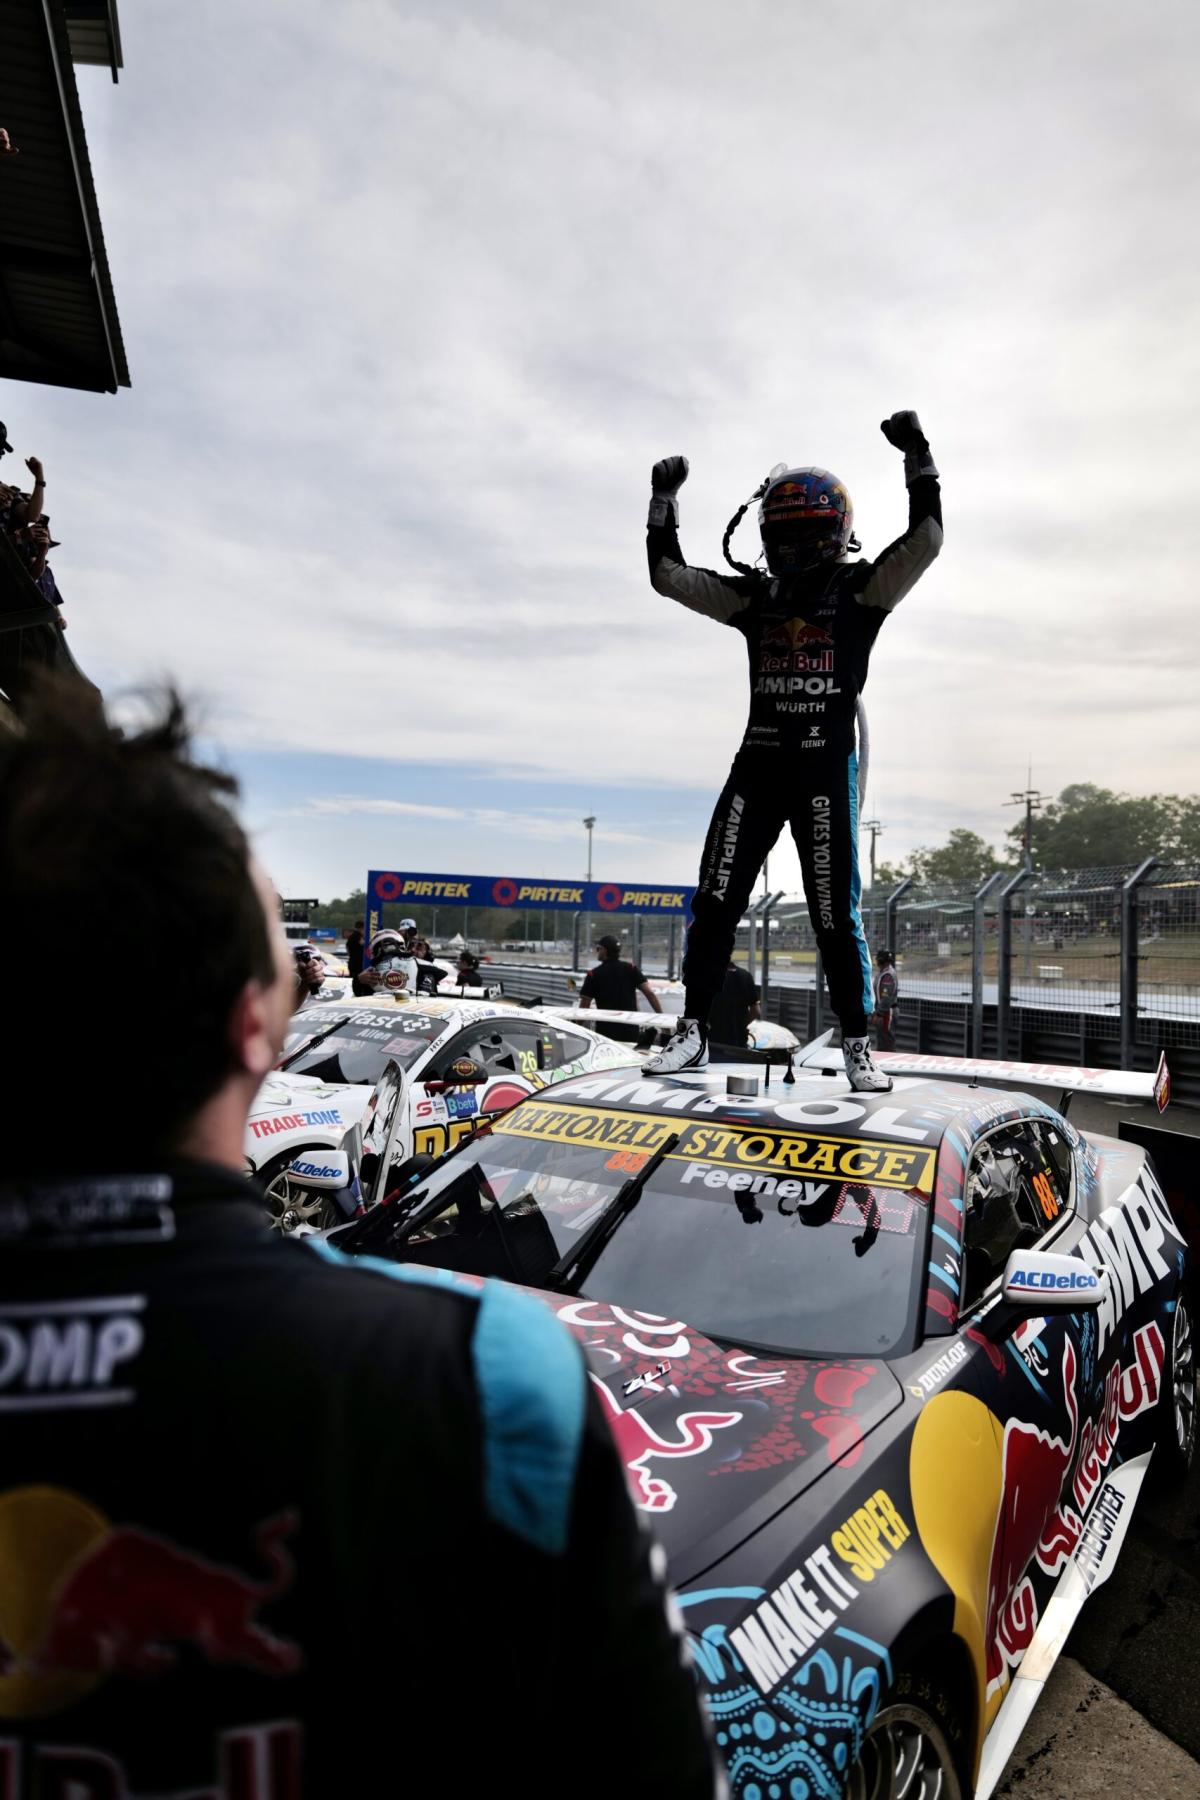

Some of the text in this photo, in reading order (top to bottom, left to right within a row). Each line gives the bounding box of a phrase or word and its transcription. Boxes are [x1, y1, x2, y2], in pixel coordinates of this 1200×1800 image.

[793, 649, 834, 673] Bull
[801, 739, 826, 749] FEENEY
[811, 795, 835, 931] GIVES YOU WINGS
[402, 880, 471, 898] PIRTEK
[518, 886, 584, 903] PIRTEK
[622, 891, 686, 908] PIRTEK
[357, 1028, 394, 1041] Allen
[519, 1050, 538, 1073] 26
[457, 1097, 475, 1111] betr
[542, 1078, 930, 1141] AMPOL
[249, 1109, 343, 1138] TRADEZONE
[502, 1106, 918, 1183] NATIONAL STORAGE
[288, 1160, 342, 1178] ACDelco
[604, 1150, 651, 1174] 88
[680, 1163, 829, 1207] Feeney
[1032, 1172, 1059, 1221] 88
[1009, 1270, 1098, 1289] ACDelco
[918, 1341, 968, 1392] DUNLOP
[729, 1488, 911, 1694] MAKE IT SUPER
